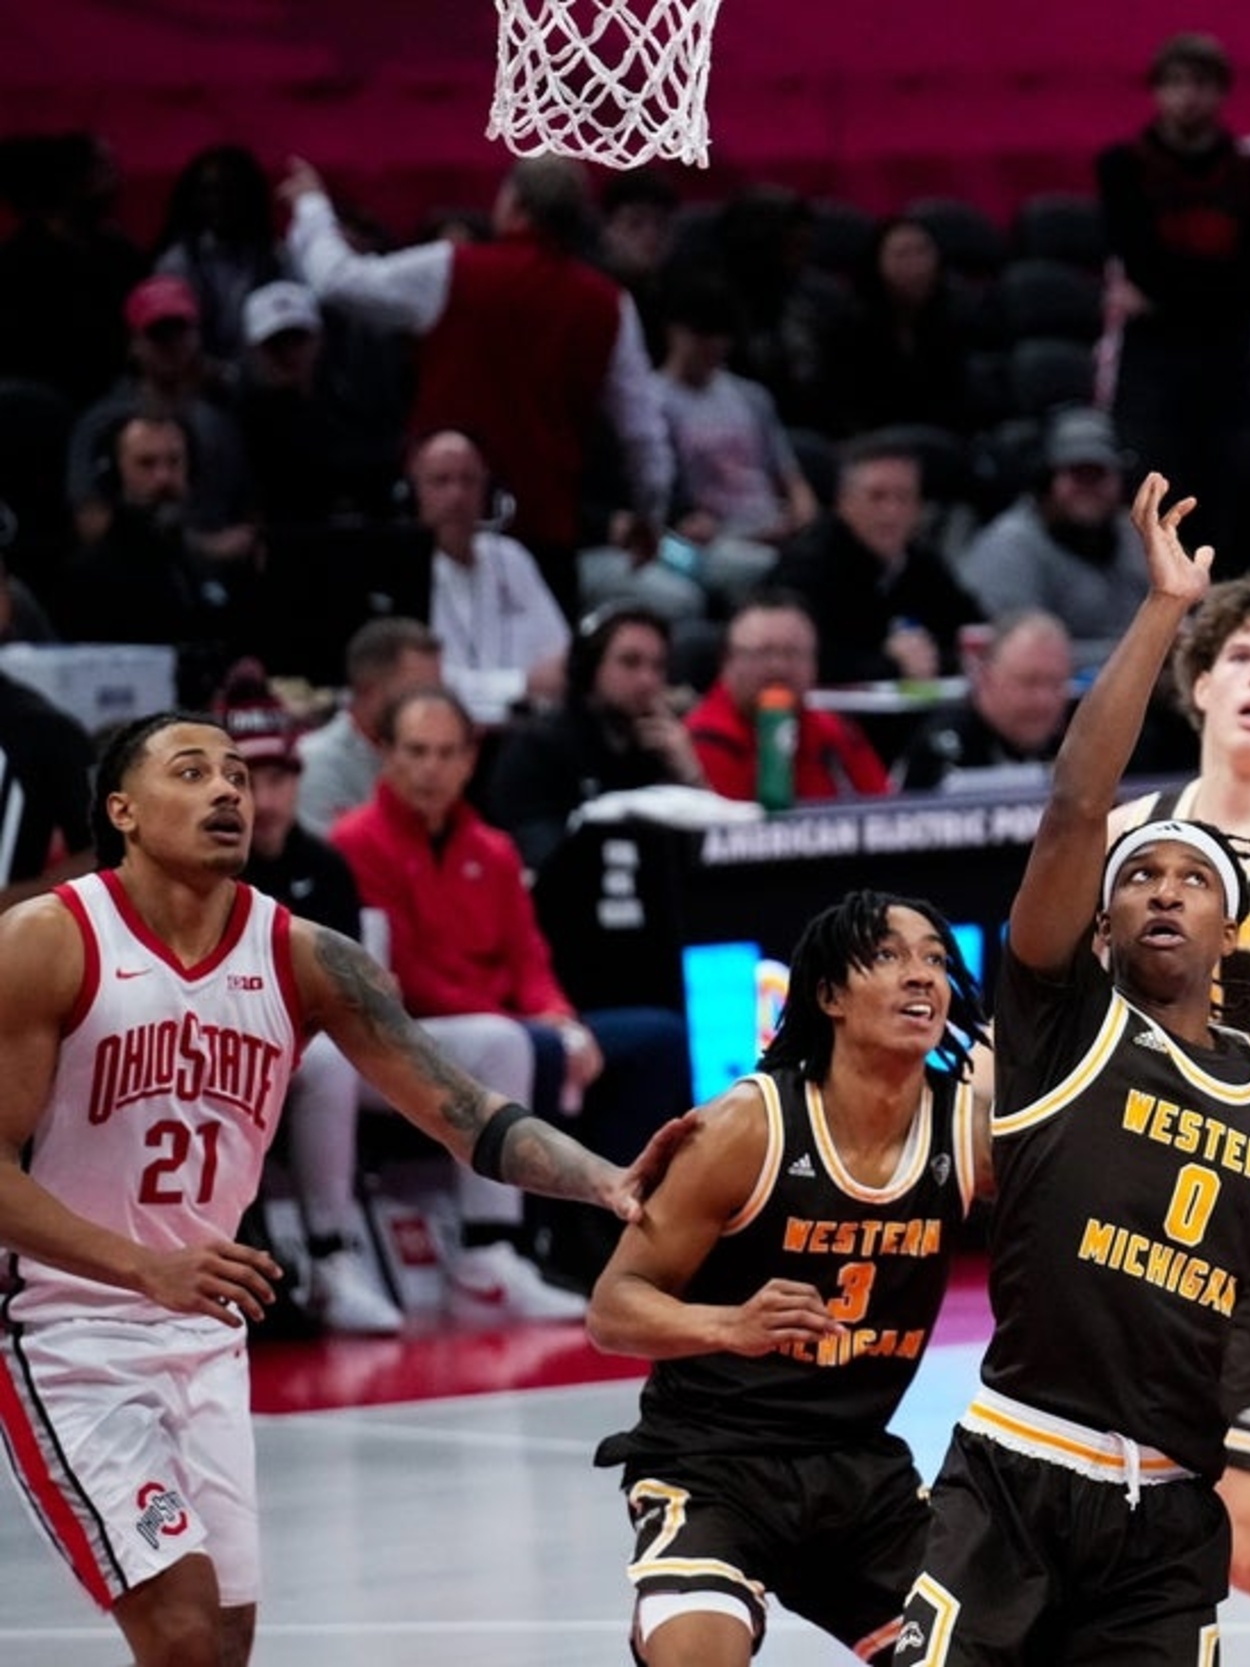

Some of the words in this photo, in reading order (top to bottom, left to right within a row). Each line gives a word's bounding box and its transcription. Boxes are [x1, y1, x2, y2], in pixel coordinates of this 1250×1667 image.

[138, 1119, 222, 1205] 21
[1163, 1161, 1222, 1248] 0
[782, 1216, 942, 1258] WESTERN
[1077, 1217, 1239, 1318] MICHIGAN
[827, 1261, 877, 1323] 3
